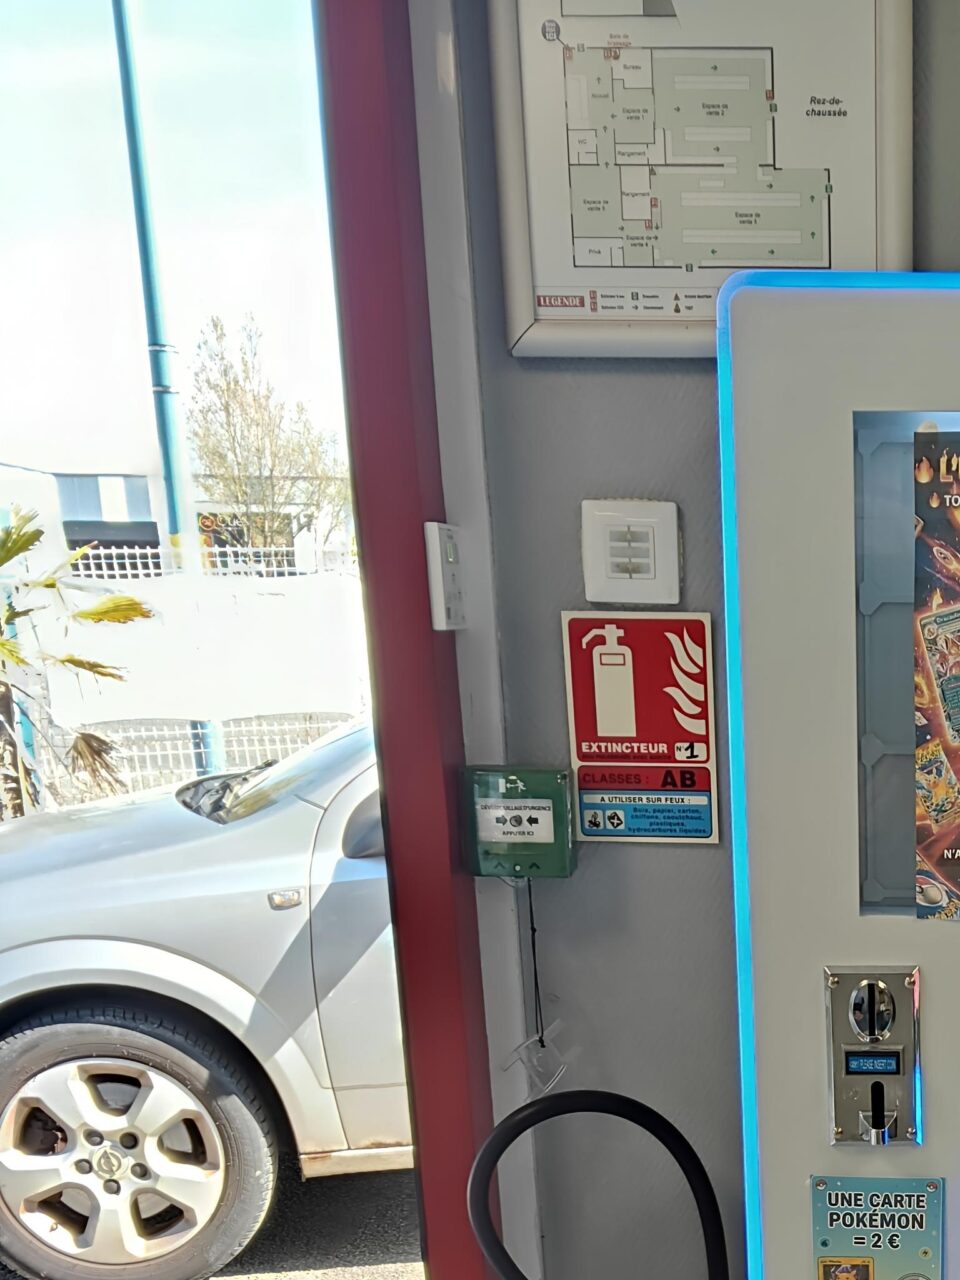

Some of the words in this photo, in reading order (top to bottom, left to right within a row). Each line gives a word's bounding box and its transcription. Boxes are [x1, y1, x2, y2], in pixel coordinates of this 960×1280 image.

[809, 96, 843, 105] Rez-de-
[805, 107, 848, 117] chaussée
[581, 742, 668, 753] EXTINCTEUR
[685, 742, 699, 759] 1
[584, 773, 642, 784] CLASSES
[827, 1191, 863, 1208] UNE
[869, 1192, 926, 1209] CARTE
[828, 1209, 924, 1230] POKÉMON
[871, 1233, 882, 1249] 2
[887, 1233, 900, 1249] €
